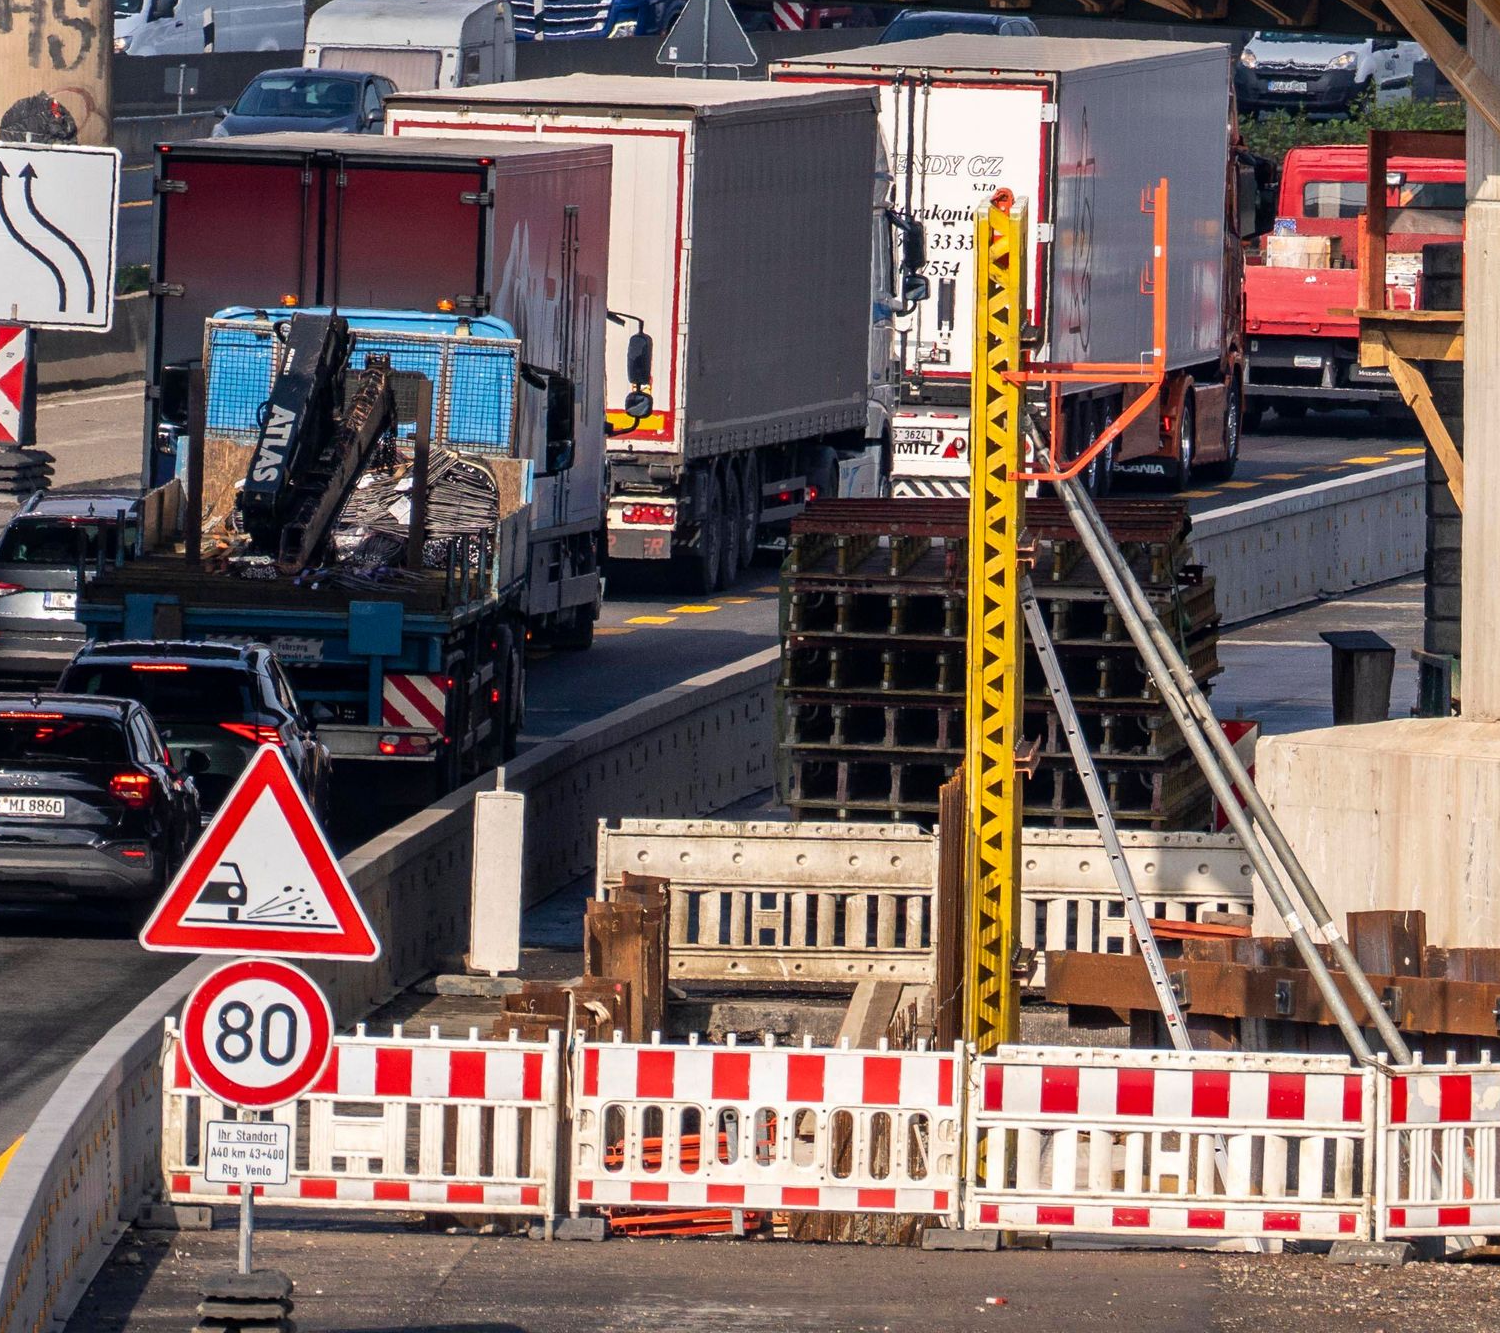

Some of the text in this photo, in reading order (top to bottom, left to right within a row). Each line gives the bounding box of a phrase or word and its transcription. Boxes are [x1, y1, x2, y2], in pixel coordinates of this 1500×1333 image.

[967, 155, 1005, 177] CZ
[253, 403, 297, 483] ATLAS
[1112, 463, 1165, 474] SCANIA
[9, 799, 26, 812] MI
[215, 1000, 298, 1067] 80
[218, 1129, 277, 1143] Ihr Standort
[211, 1146, 284, 1161] A40 km 43+400
[245, 1165, 271, 1177] Venlo
